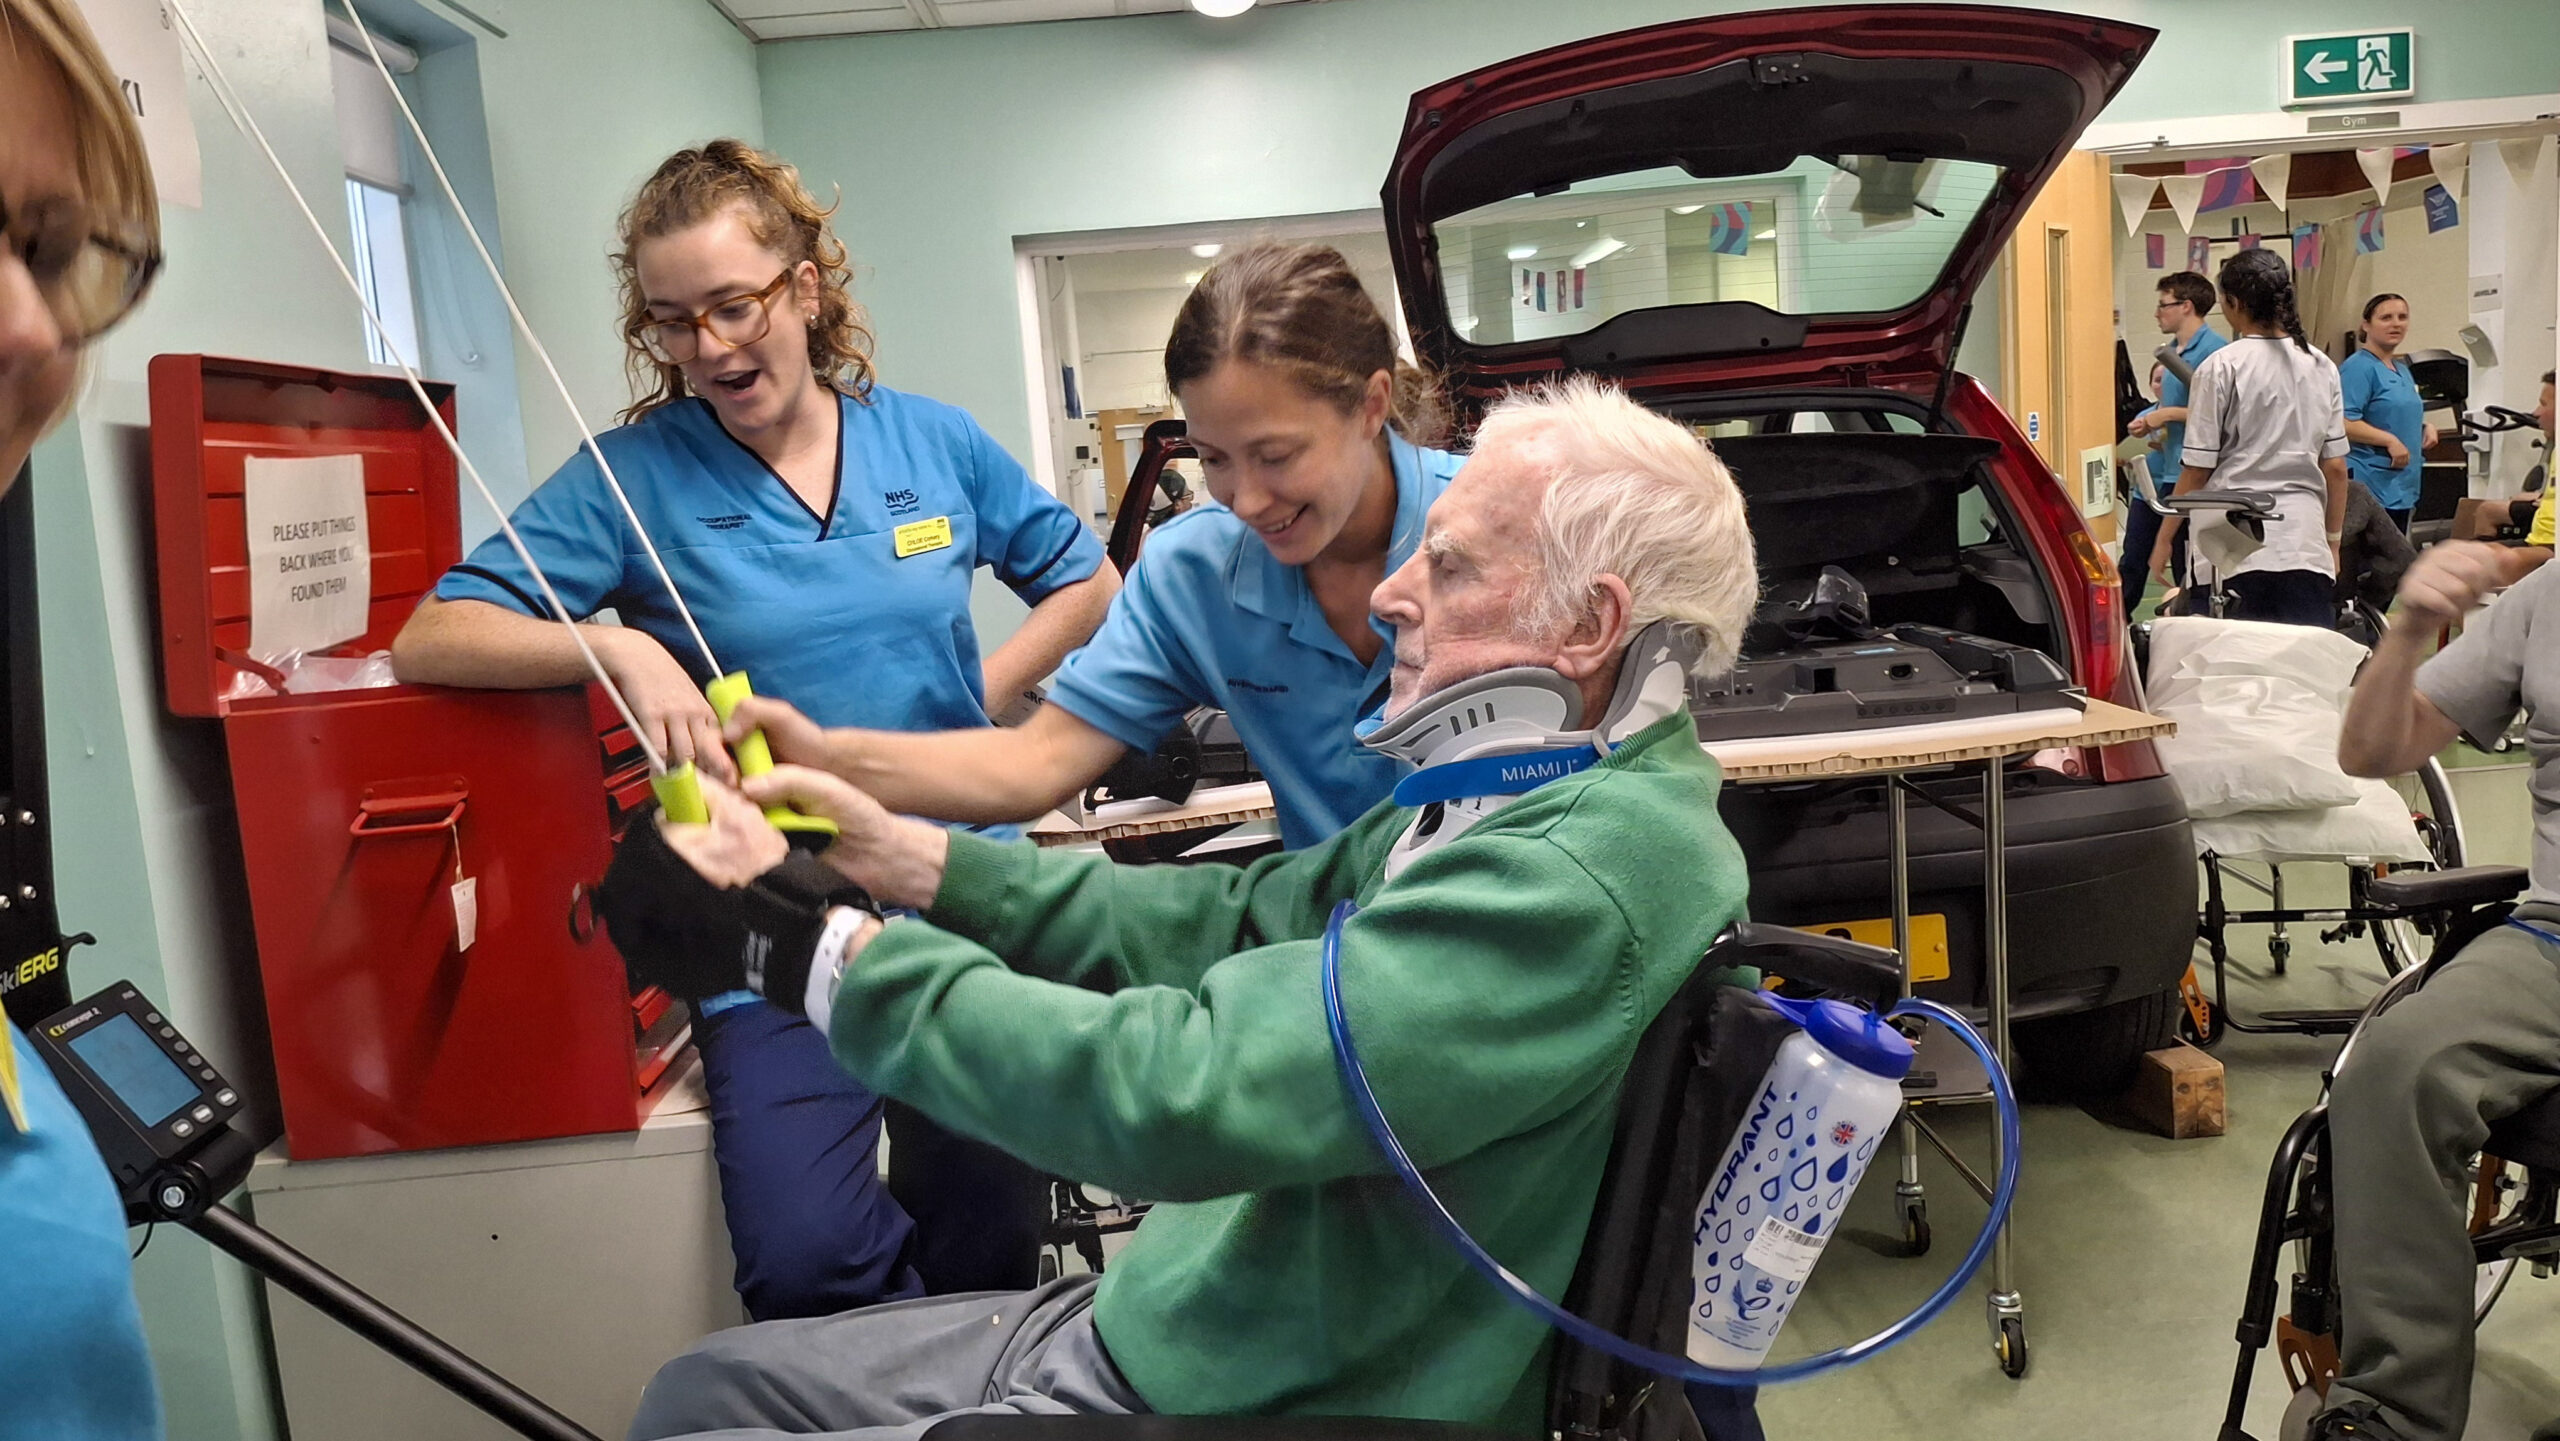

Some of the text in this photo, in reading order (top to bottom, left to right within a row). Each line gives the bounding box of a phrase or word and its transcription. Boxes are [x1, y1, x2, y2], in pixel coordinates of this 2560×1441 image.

[2341, 116, 2367, 128] Gym
[884, 488, 915, 504] NHS
[890, 505, 921, 516] SCOTLAND
[273, 515, 356, 542] PLEASE PUT THINGS
[280, 546, 355, 573] BACK WHERE YOU
[291, 576, 347, 602] FOUND THEM
[1501, 761, 1561, 782] MIAMI
[1694, 1080, 1777, 1246] HYDRANT
